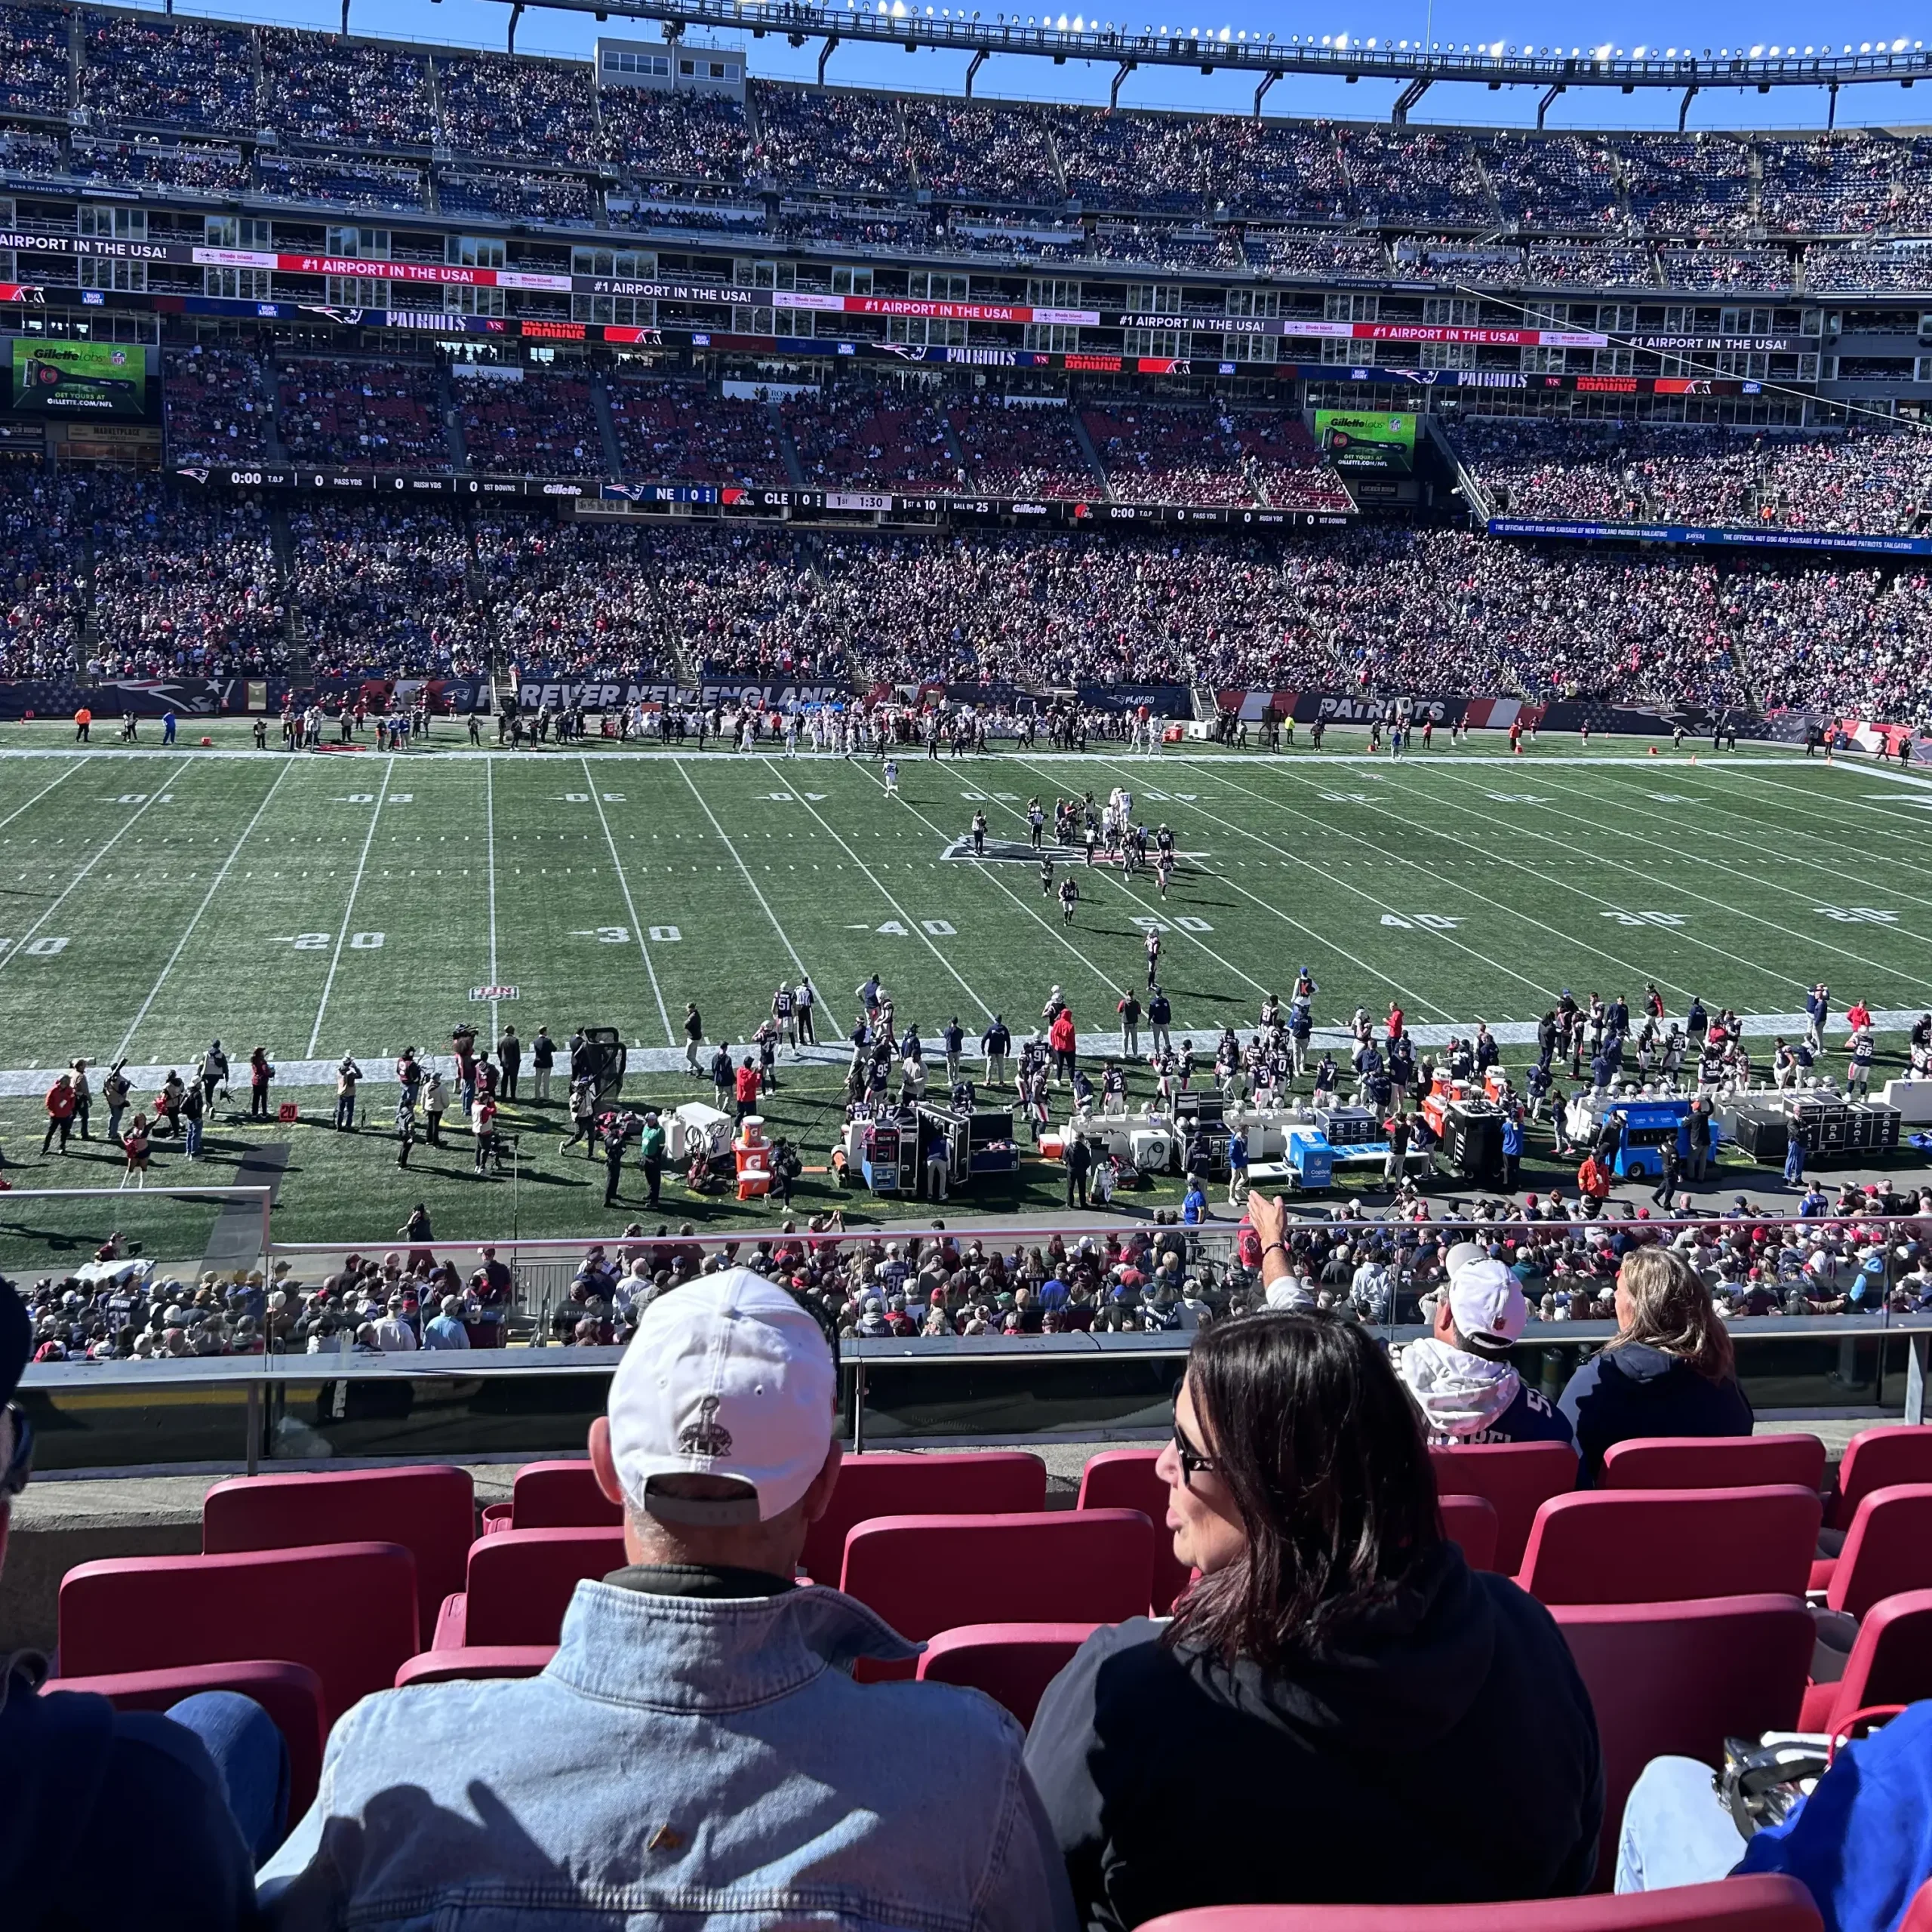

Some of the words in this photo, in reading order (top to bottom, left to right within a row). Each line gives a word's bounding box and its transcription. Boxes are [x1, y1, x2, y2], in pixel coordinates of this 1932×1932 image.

[0, 234, 68, 251] AIRPORT
[74, 240, 90, 252] IN
[95, 242, 126, 255] THE
[131, 245, 167, 259] USA!
[302, 258, 318, 270] #1
[321, 260, 385, 275] AIRPORT
[389, 265, 405, 277] IN
[408, 266, 436, 279] THE
[441, 269, 474, 282] USA!
[594, 281, 609, 292] #1
[612, 282, 670, 297] AIRPORT
[674, 288, 688, 298] IN
[691, 288, 717, 300] THE
[721, 291, 752, 303] USA!
[865, 301, 878, 311] #1
[881, 302, 936, 315] AIRPORT
[940, 304, 952, 315] IN
[957, 306, 980, 317] THE
[984, 308, 1012, 319] USA!
[1119, 315, 1133, 325] #1
[1136, 316, 1189, 328] AIRPORT
[1192, 318, 1204, 329] IN
[1209, 320, 1232, 331] THE
[1236, 321, 1264, 332] USA!
[1373, 328, 1386, 337] #1
[1389, 328, 1442, 340] AIRPORT
[1446, 330, 1459, 340] IN
[1463, 331, 1486, 341] THE
[1490, 332, 1518, 343] USA!
[1629, 337, 1642, 346] #1
[1646, 337, 1704, 349] AIRPORT
[1707, 339, 1721, 349] IN
[1725, 340, 1751, 349] THE
[1755, 340, 1787, 350] USA!
[47, 398, 113, 408] GILLETTE.COM/NFL
[93, 426, 140, 435] MARKETPLACE
[232, 472, 262, 484] 0:00
[315, 475, 324, 487] 0
[395, 478, 404, 489] 0
[470, 481, 478, 492] 0
[543, 484, 582, 495] Gillette
[657, 488, 675, 500] NE
[691, 489, 699, 500] 0
[764, 492, 789, 505] CLE
[802, 494, 810, 506] 0
[837, 496, 848, 506] 1ST
[860, 497, 883, 508] 1:30
[903, 499, 915, 509] 1ST
[924, 500, 937, 510] 10
[976, 502, 989, 512] 25
[1012, 503, 1047, 514] Gillette
[1110, 507, 1135, 518] 0:00
[1177, 509, 1185, 520] 0
[1244, 512, 1251, 523] 0
[1307, 515, 1315, 525] 0
[1734, 534, 1755, 542] OFFICIAL
[1789, 536, 1813, 544] SAUSAGE
[1884, 541, 1912, 549] TAILGATING
[626, 685, 698, 707] NEW
[701, 685, 835, 706] ENGLAND
[1321, 698, 1445, 721] PATRIOTS
[118, 794, 175, 804] 10
[346, 793, 414, 803] 20
[565, 793, 626, 801] 30
[769, 792, 828, 801] 40
[960, 792, 1020, 801] 50
[1142, 792, 1198, 801] 40
[1318, 793, 1377, 801] 30
[1380, 914, 1457, 928] 40
[1599, 911, 1684, 925] 30
[1812, 908, 1900, 922] 20
[875, 919, 957, 936] 40
[1128, 916, 1214, 932] 50
[597, 925, 681, 943] 30
[294, 931, 385, 950] 20
[480, 986, 512, 995] NFL
[1300, 982, 1309, 995] K
[778, 998, 791, 1011] 51
[1033, 1051, 1046, 1062] 91
[1857, 1046, 1872, 1057] 66
[1278, 1060, 1286, 1072] 0
[1260, 1070, 1270, 1084] 31
[1327, 1069, 1334, 1081] 7
[1113, 1078, 1121, 1090] 2
[281, 1105, 297, 1119] 20
[854, 1112, 870, 1121] 97
[1429, 1113, 1435, 1125] G
[750, 1128, 758, 1137] G
[746, 1155, 761, 1169] G
[1011, 1160, 1017, 1169] 9
[1816, 1206, 1827, 1217] 11
[1029, 1281, 1040, 1297] 11
[679, 1437, 732, 1457] XLIX
